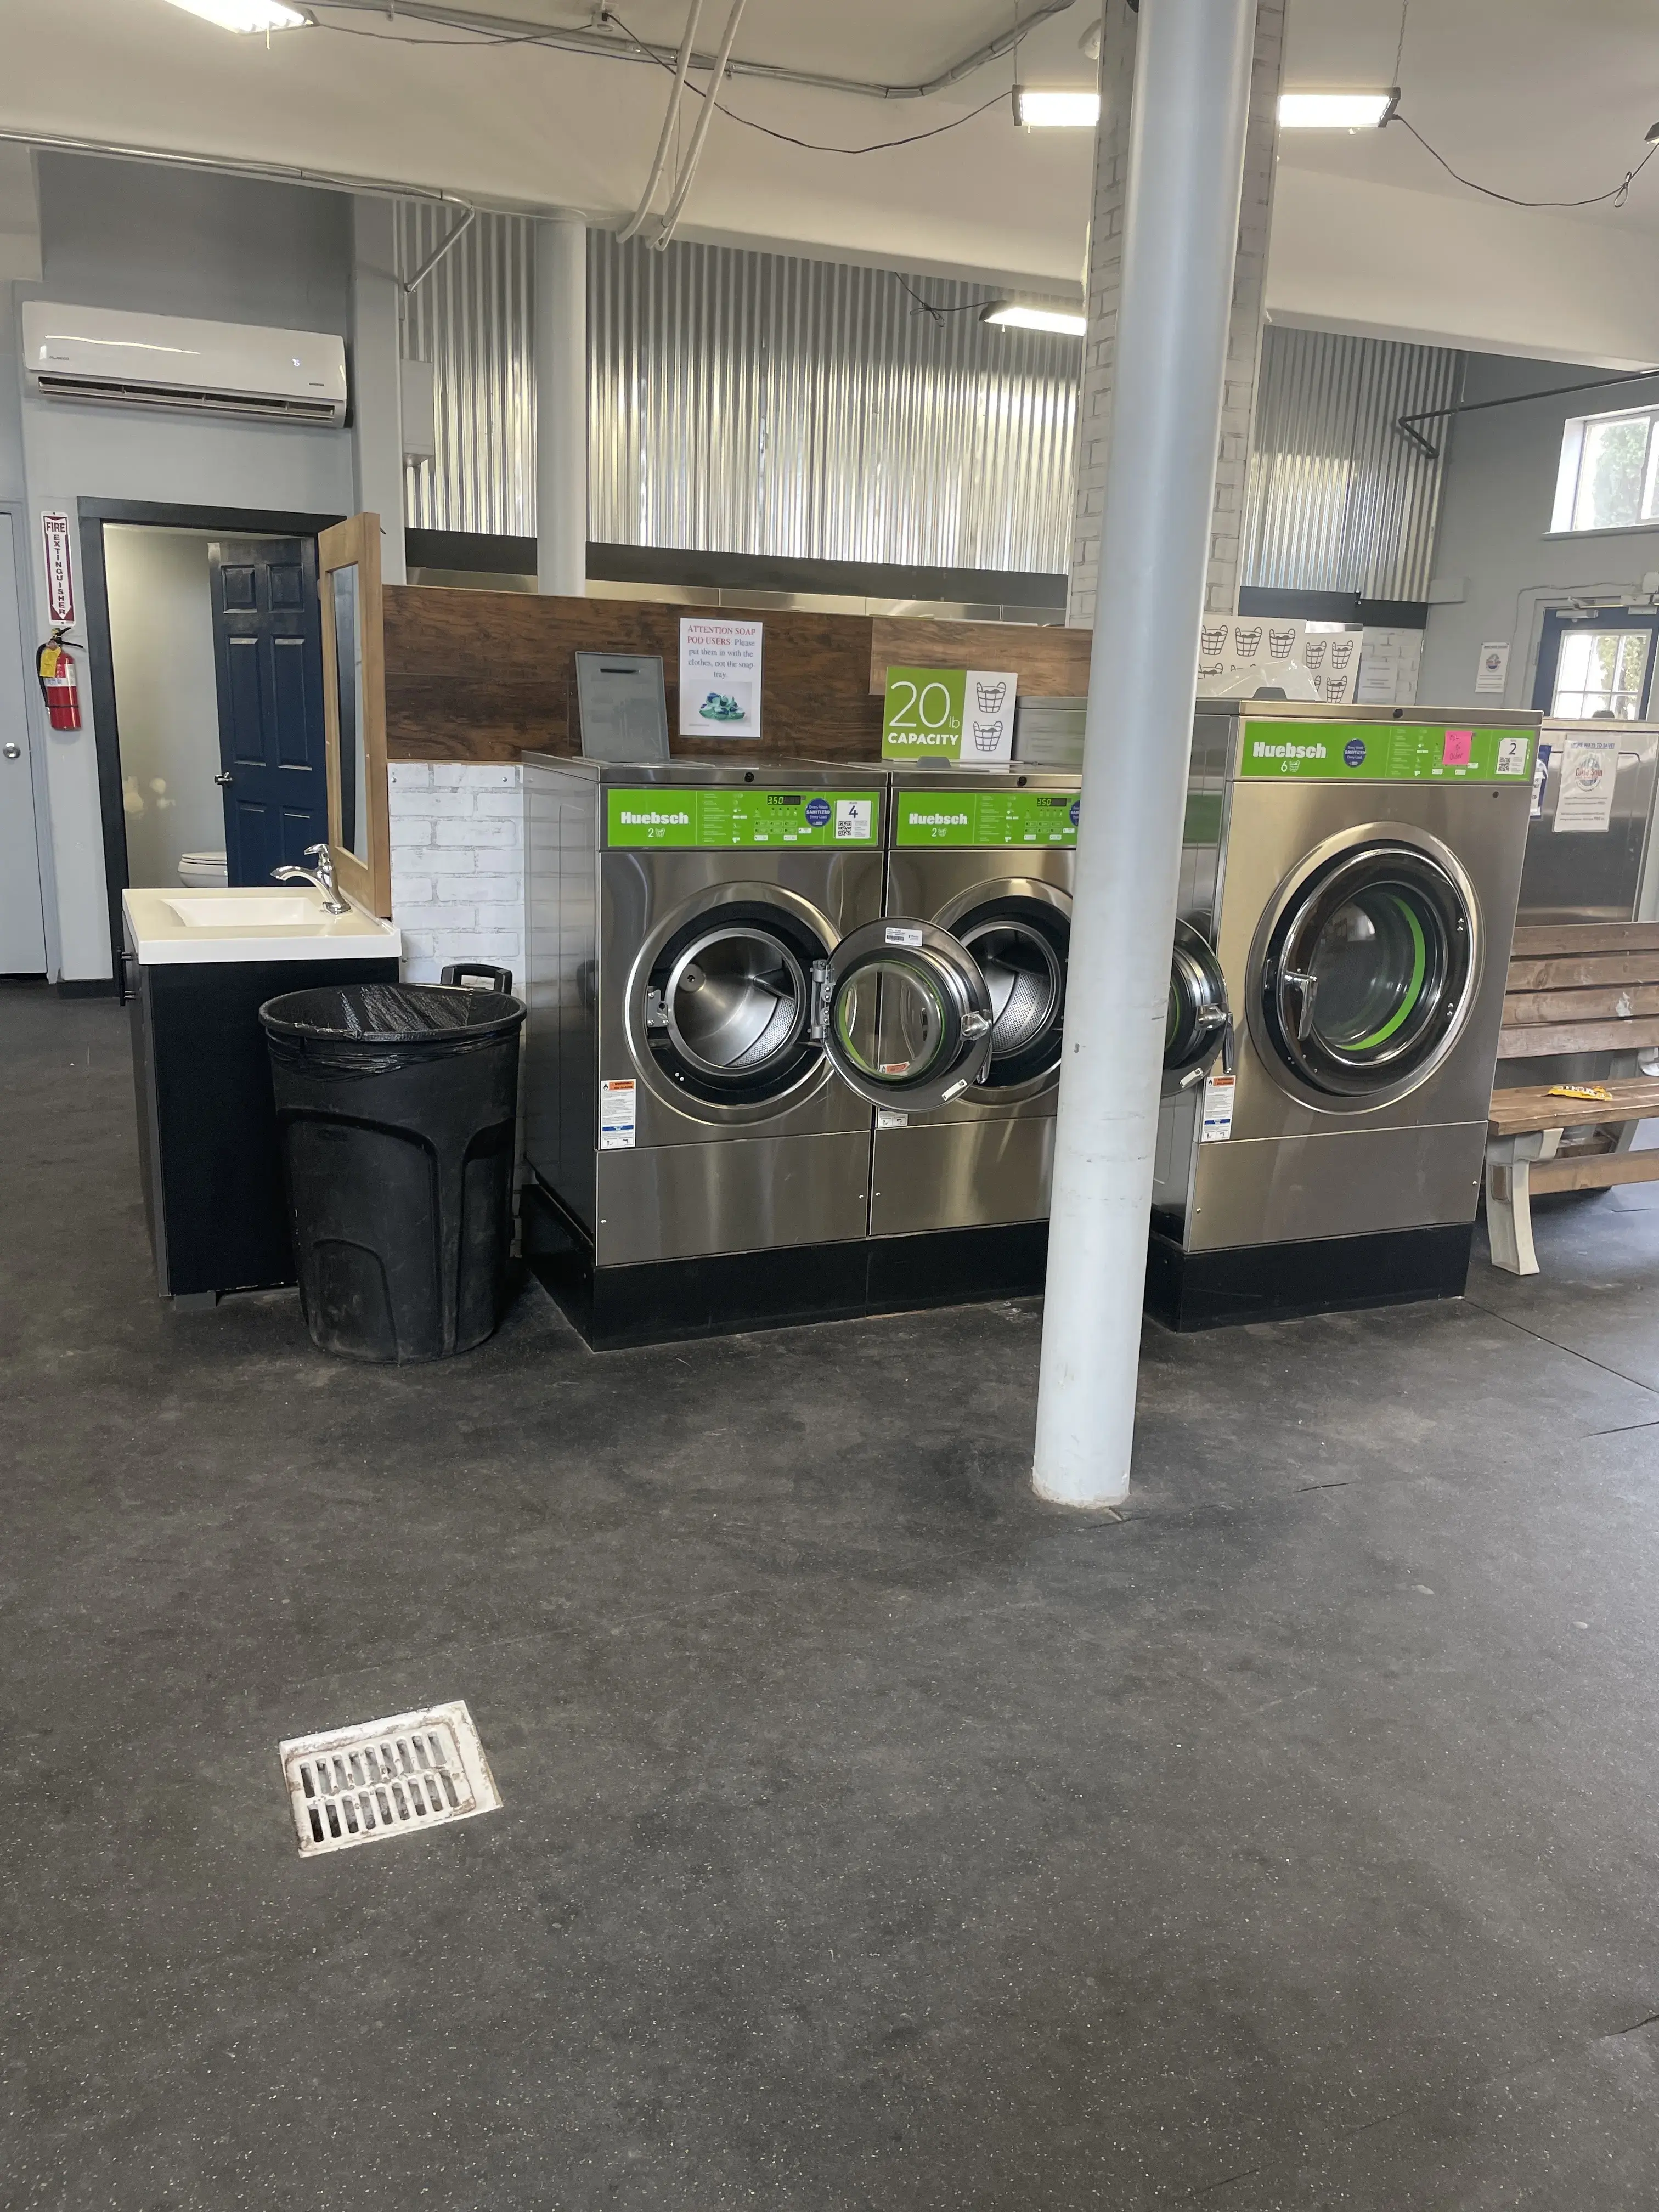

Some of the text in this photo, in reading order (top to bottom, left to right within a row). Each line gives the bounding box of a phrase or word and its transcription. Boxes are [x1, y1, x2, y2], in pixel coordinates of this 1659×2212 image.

[46, 522, 65, 533] FIRE
[53, 534, 65, 615] EXTINGUISHER
[687, 625, 755, 636] ATTENTION SOAP
[735, 639, 755, 647] Please
[688, 659, 713, 667] clothes,
[889, 681, 960, 729] 20 lb
[888, 732, 958, 746] CAPACITY
[1253, 742, 1327, 758] Huebsch
[1508, 743, 1517, 755] 2
[1280, 760, 1288, 772] 6
[848, 805, 859, 818] 4
[620, 812, 689, 825] Huebsch
[909, 813, 968, 825] Huebsch
[648, 827, 654, 838] 2
[932, 827, 938, 837] 2
